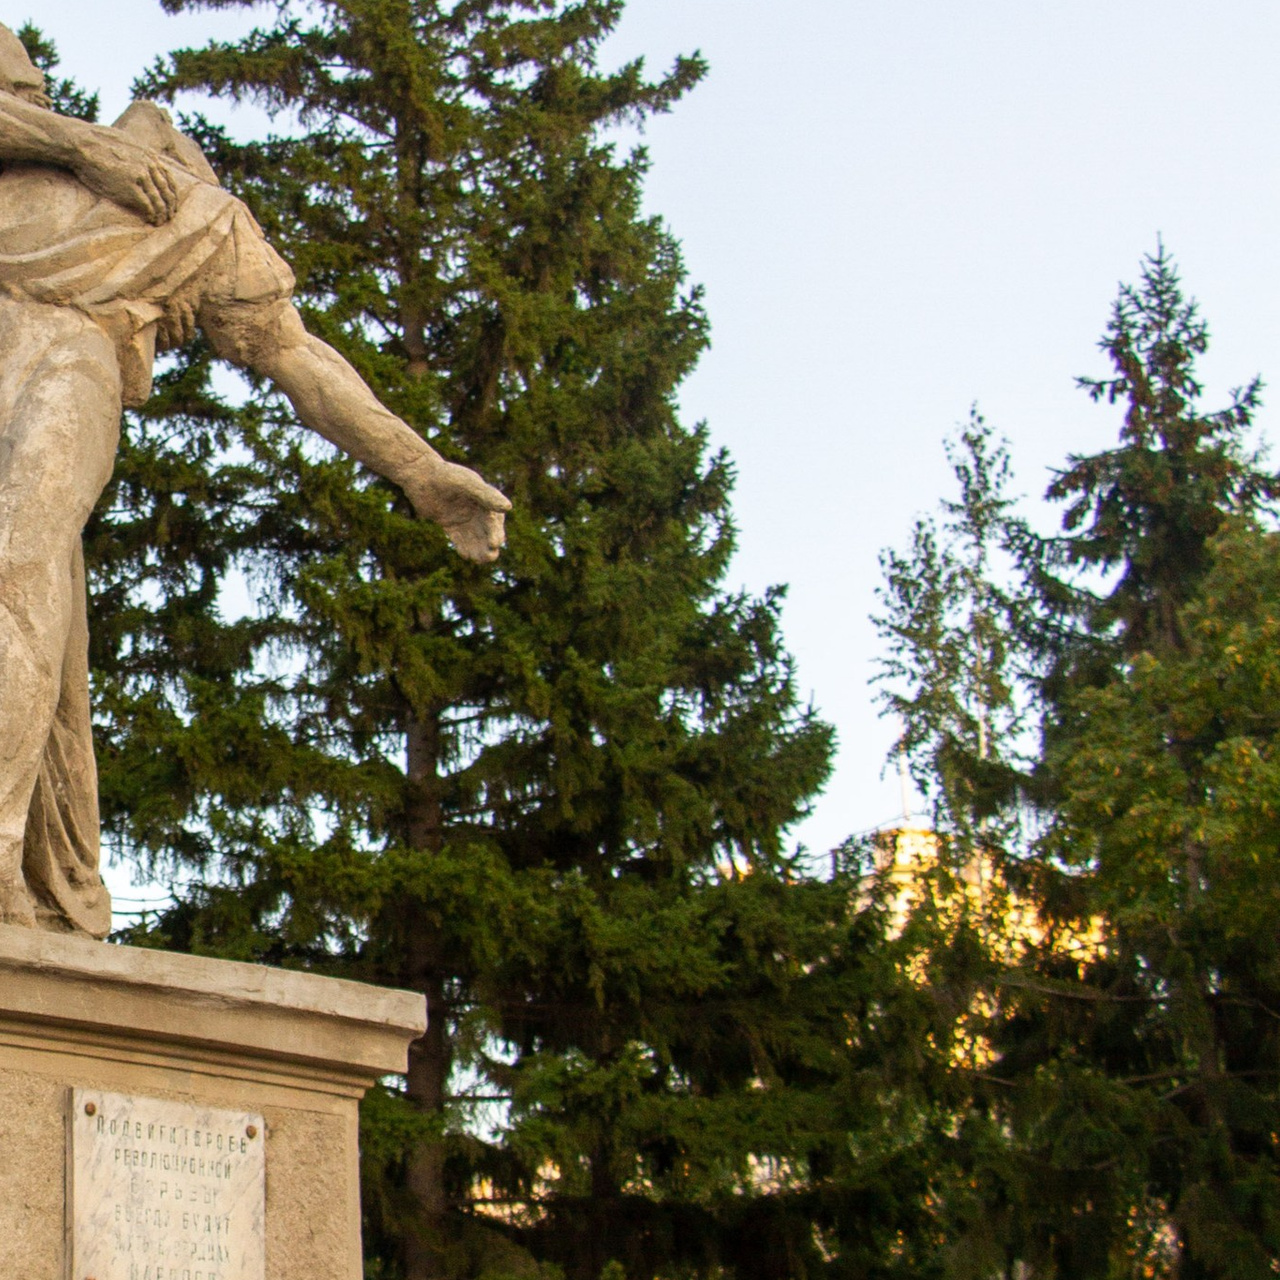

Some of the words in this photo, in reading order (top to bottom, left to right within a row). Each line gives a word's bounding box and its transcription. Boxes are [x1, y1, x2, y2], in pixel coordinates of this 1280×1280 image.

[97, 1115, 176, 1144] ПОДВИГИ
[183, 1127, 248, 1154] ГЕРОЕВ
[115, 1148, 231, 1180] РЕВОЛЮЦИОННОЙ
[182, 1212, 231, 1235] БУДУТ
